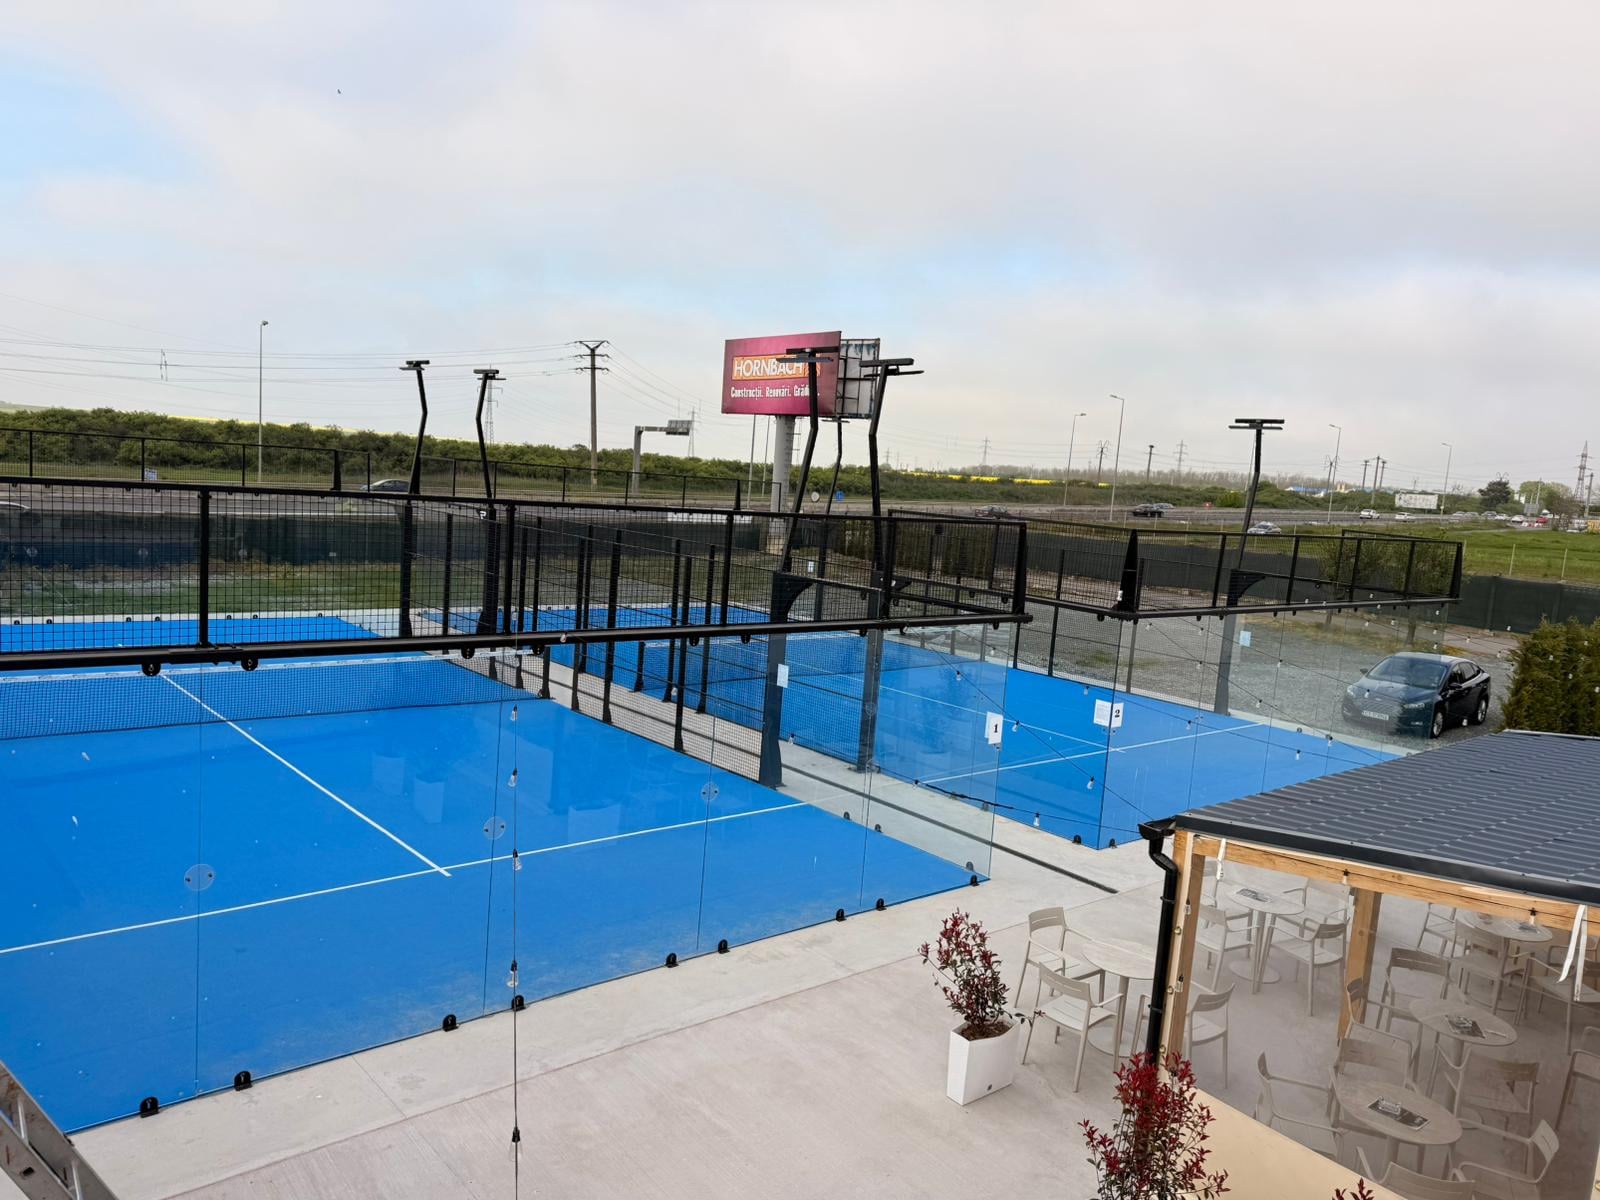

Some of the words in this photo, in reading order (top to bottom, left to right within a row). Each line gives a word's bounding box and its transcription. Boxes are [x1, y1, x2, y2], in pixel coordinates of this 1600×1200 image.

[734, 357, 803, 377] HORNBACH
[1114, 709, 1121, 718] 2
[994, 723, 999, 733] 1
